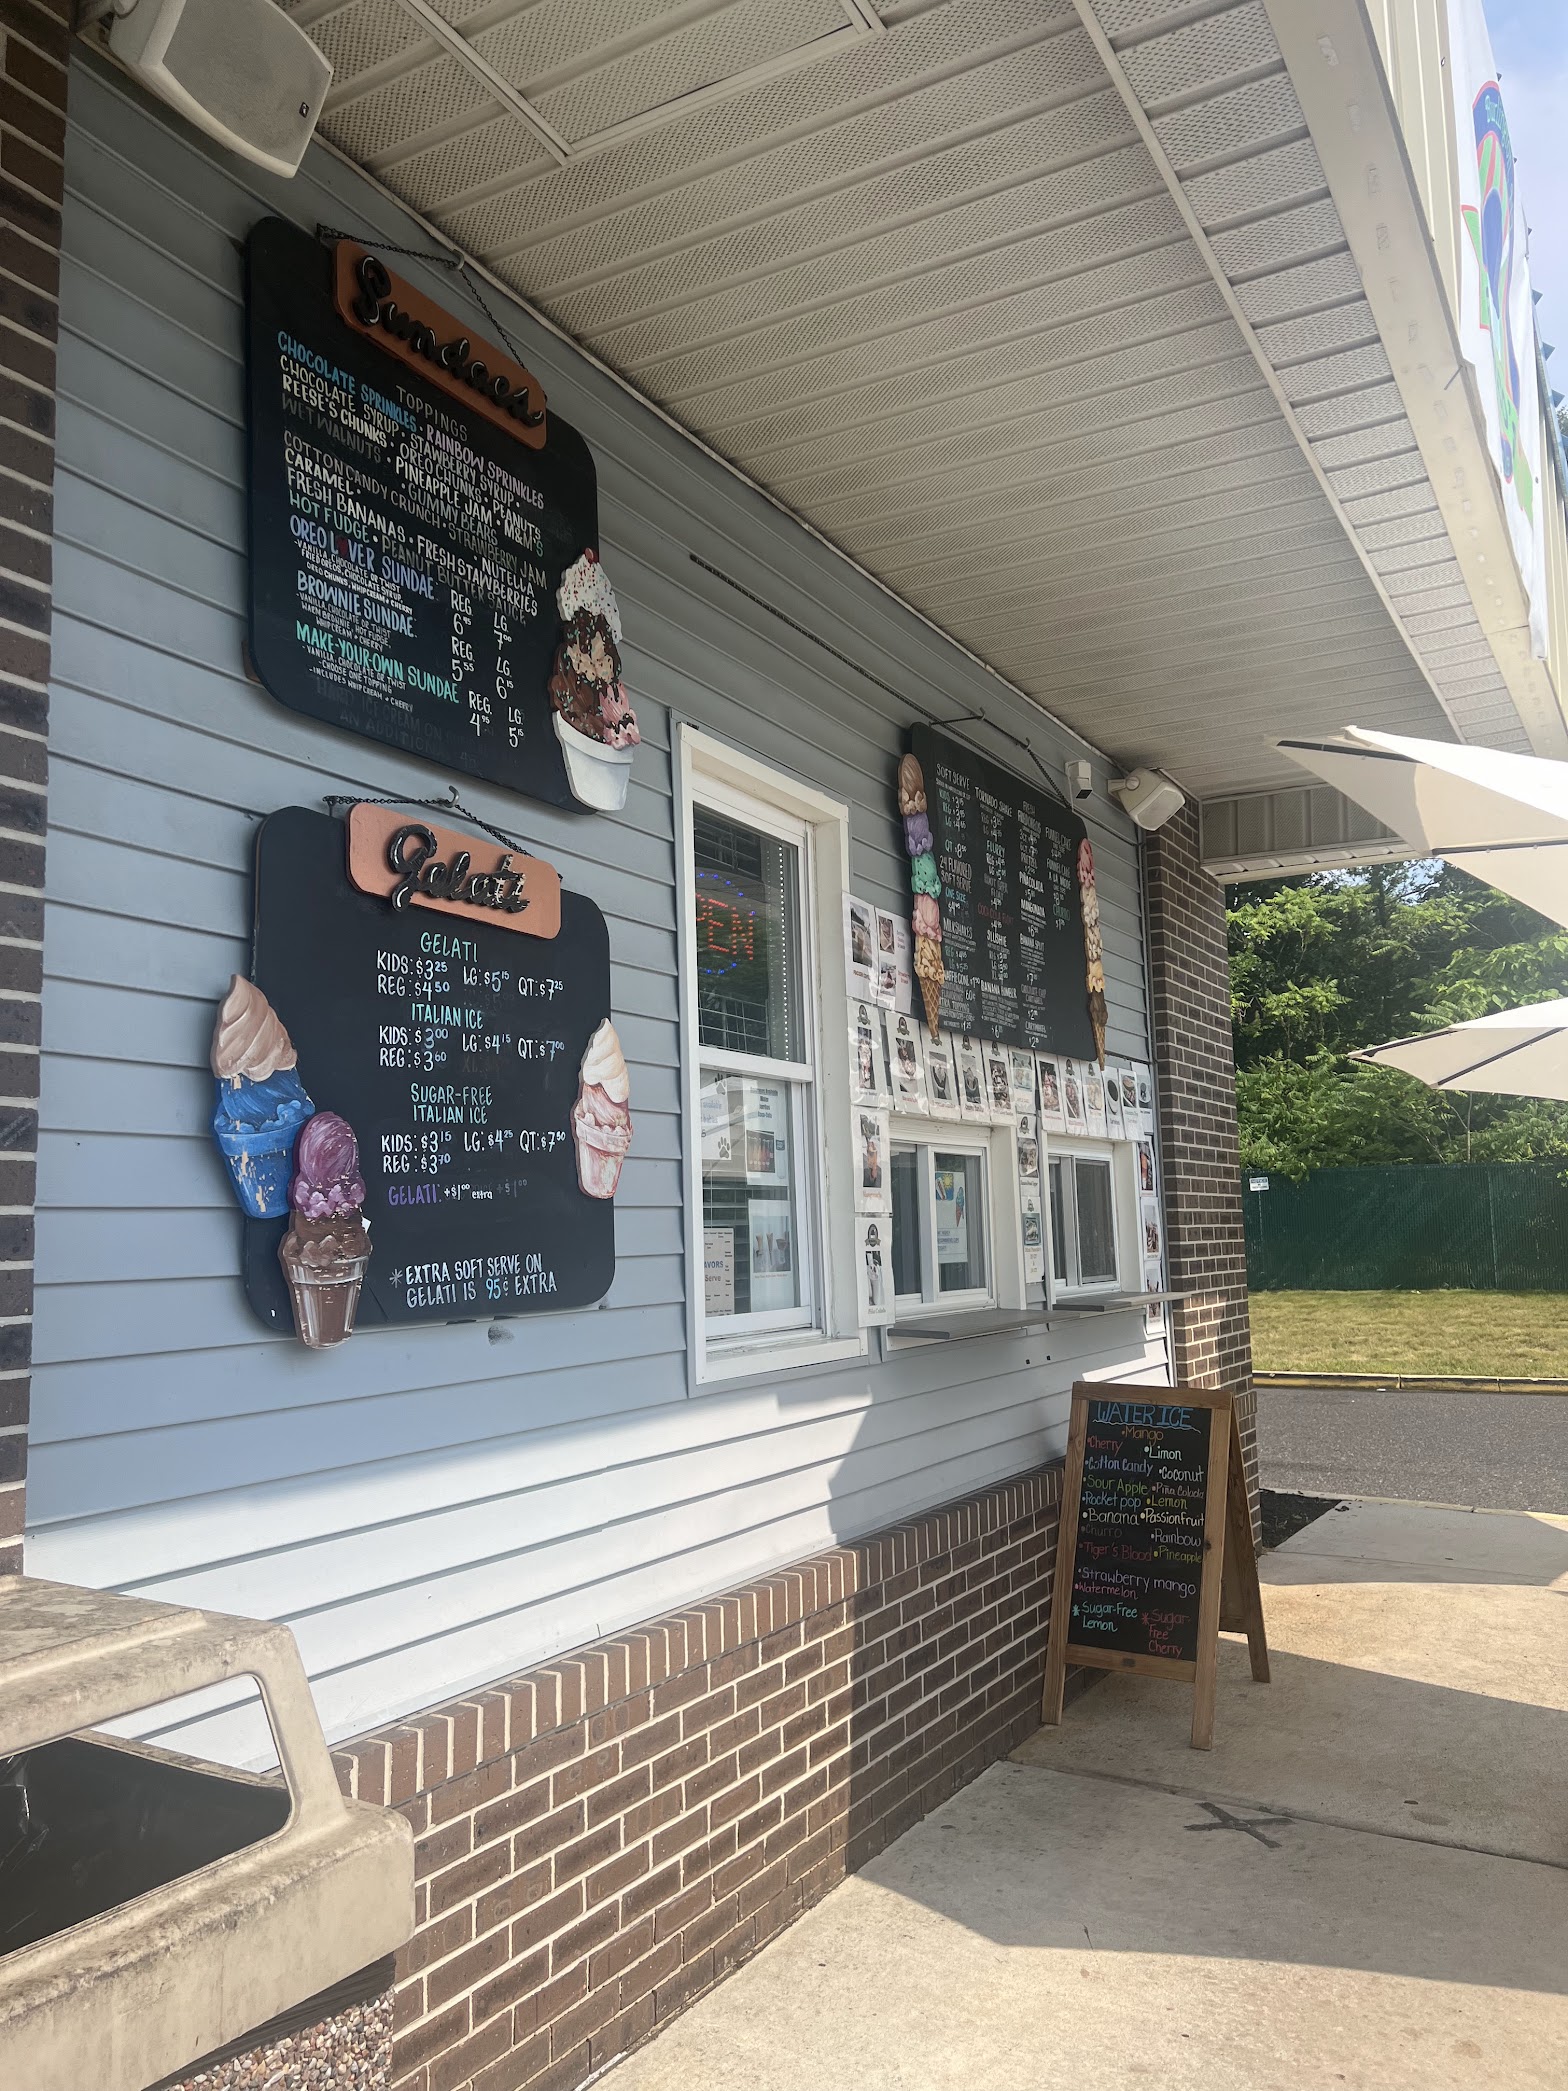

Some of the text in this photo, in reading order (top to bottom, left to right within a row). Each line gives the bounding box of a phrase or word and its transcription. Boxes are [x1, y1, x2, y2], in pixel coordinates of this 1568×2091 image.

[353, 255, 545, 428] Sundaes
[278, 331, 544, 509] CHOCOLATE SPRINKLES RAINBOW SPRINKLES
[396, 385, 467, 441] TOPPINGS
[280, 355, 514, 507] CHOCOLATE SYRUP STAWBERRY SYRUP
[283, 374, 338, 418] REESE'S
[341, 409, 387, 448] CHUNKS
[400, 443, 433, 475] OREO
[436, 464, 480, 503] CHUNKS
[318, 412, 380, 463] WALNUTS
[396, 456, 460, 508] PINEAPPLE
[464, 499, 492, 527] JAM
[285, 448, 535, 598] CARAMEL NUTELLA
[408, 483, 498, 546] GUMMY BEARS
[290, 515, 326, 549] OREO
[346, 465, 387, 500] CANDY
[391, 490, 440, 528] CRUNCH
[449, 523, 518, 574] STRAWBERRY
[520, 561, 547, 590] JAM
[287, 467, 538, 616] FRESH BANANAS FRESH STAWBERRIES
[290, 489, 320, 518] HOT
[324, 508, 369, 543] FUDGE
[382, 535, 433, 576] PEANUT
[437, 565, 484, 601] BUTTER
[297, 570, 361, 616] BROWNIE
[296, 620, 403, 681] MAKE-YOUR-OWN
[469, 690, 493, 715] REG.
[937, 763, 951, 782] SOFT
[953, 771, 970, 790] SERVE
[387, 824, 531, 913] Gelati
[941, 869, 972, 893] SOFT SERVE
[945, 887, 966, 903] ONE SIZE
[943, 917, 973, 939] MILKSHAKES
[421, 932, 478, 963] GELATI
[377, 950, 414, 975] KIDS:
[411, 1003, 484, 1030] ITALIAN ICE
[379, 1025, 412, 1045] KIDS:
[411, 1083, 492, 1106] SUGAR-FREE
[413, 1104, 488, 1124] ITALIAN ICE
[381, 1133, 418, 1153] KIDS:
[471, 1188, 492, 1200] extra
[405, 1253, 542, 1285] EXTRA SOFT SERVE ON
[406, 1285, 457, 1308] GELATI
[464, 1282, 477, 1300] IS
[515, 1271, 557, 1297] EXTRA
[1097, 1402, 1193, 1427] WATER ICE
[1089, 1435, 1123, 1457] Cherry
[1125, 1426, 1164, 1446] Mango
[1149, 1446, 1182, 1461] Limon
[1088, 1455, 1153, 1477] Cotton Candy
[1161, 1465, 1204, 1482] Coconut
[1087, 1475, 1148, 1497] Sour Apple
[1120, 1496, 1141, 1512] pop
[1151, 1497, 1187, 1510] Lemon
[1088, 1507, 1139, 1526] Banana
[1154, 1528, 1202, 1547] Rainbow
[1121, 1545, 1152, 1561] Blood
[1158, 1545, 1201, 1564] Pineapple
[1079, 1584, 1138, 1600] Watermelon
[1082, 1567, 1196, 1599] Strawberry mango
[1082, 1601, 1138, 1618] Sugar-Free
[1082, 1616, 1118, 1632] Lemon
[1149, 1624, 1168, 1640] Free
[1149, 1640, 1183, 1658] Cherry
